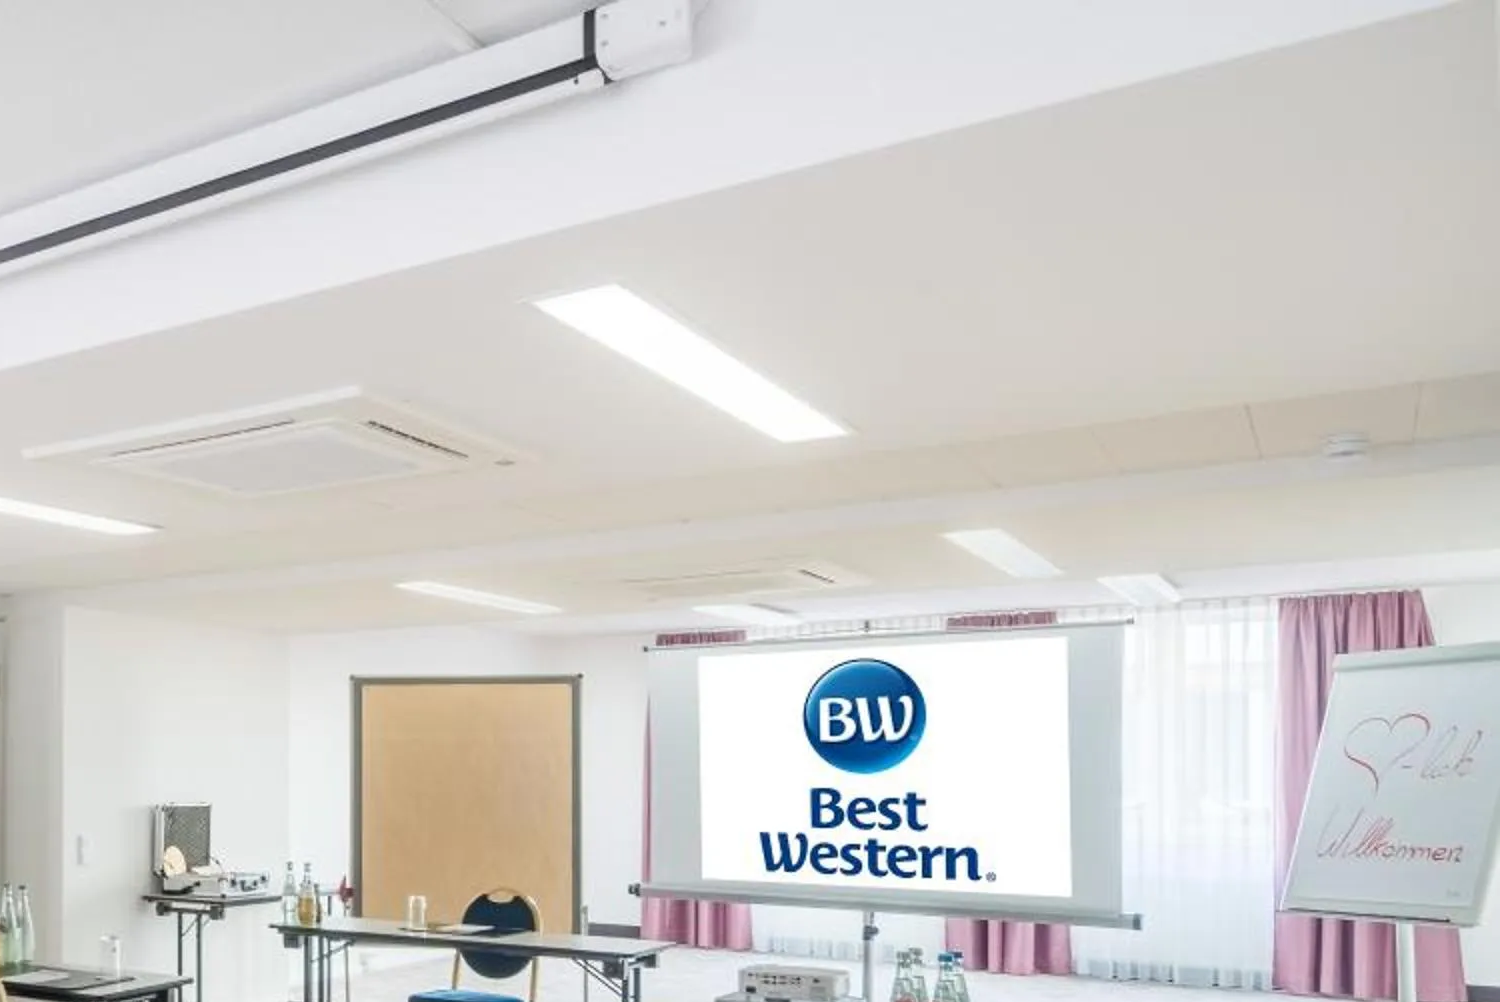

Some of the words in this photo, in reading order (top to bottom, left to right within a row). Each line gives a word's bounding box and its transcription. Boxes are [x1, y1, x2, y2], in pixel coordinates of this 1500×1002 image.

[818, 695, 914, 743] BW
[809, 787, 929, 832] Best
[1316, 803, 1465, 864] Willkommen
[759, 831, 982, 881] Western
